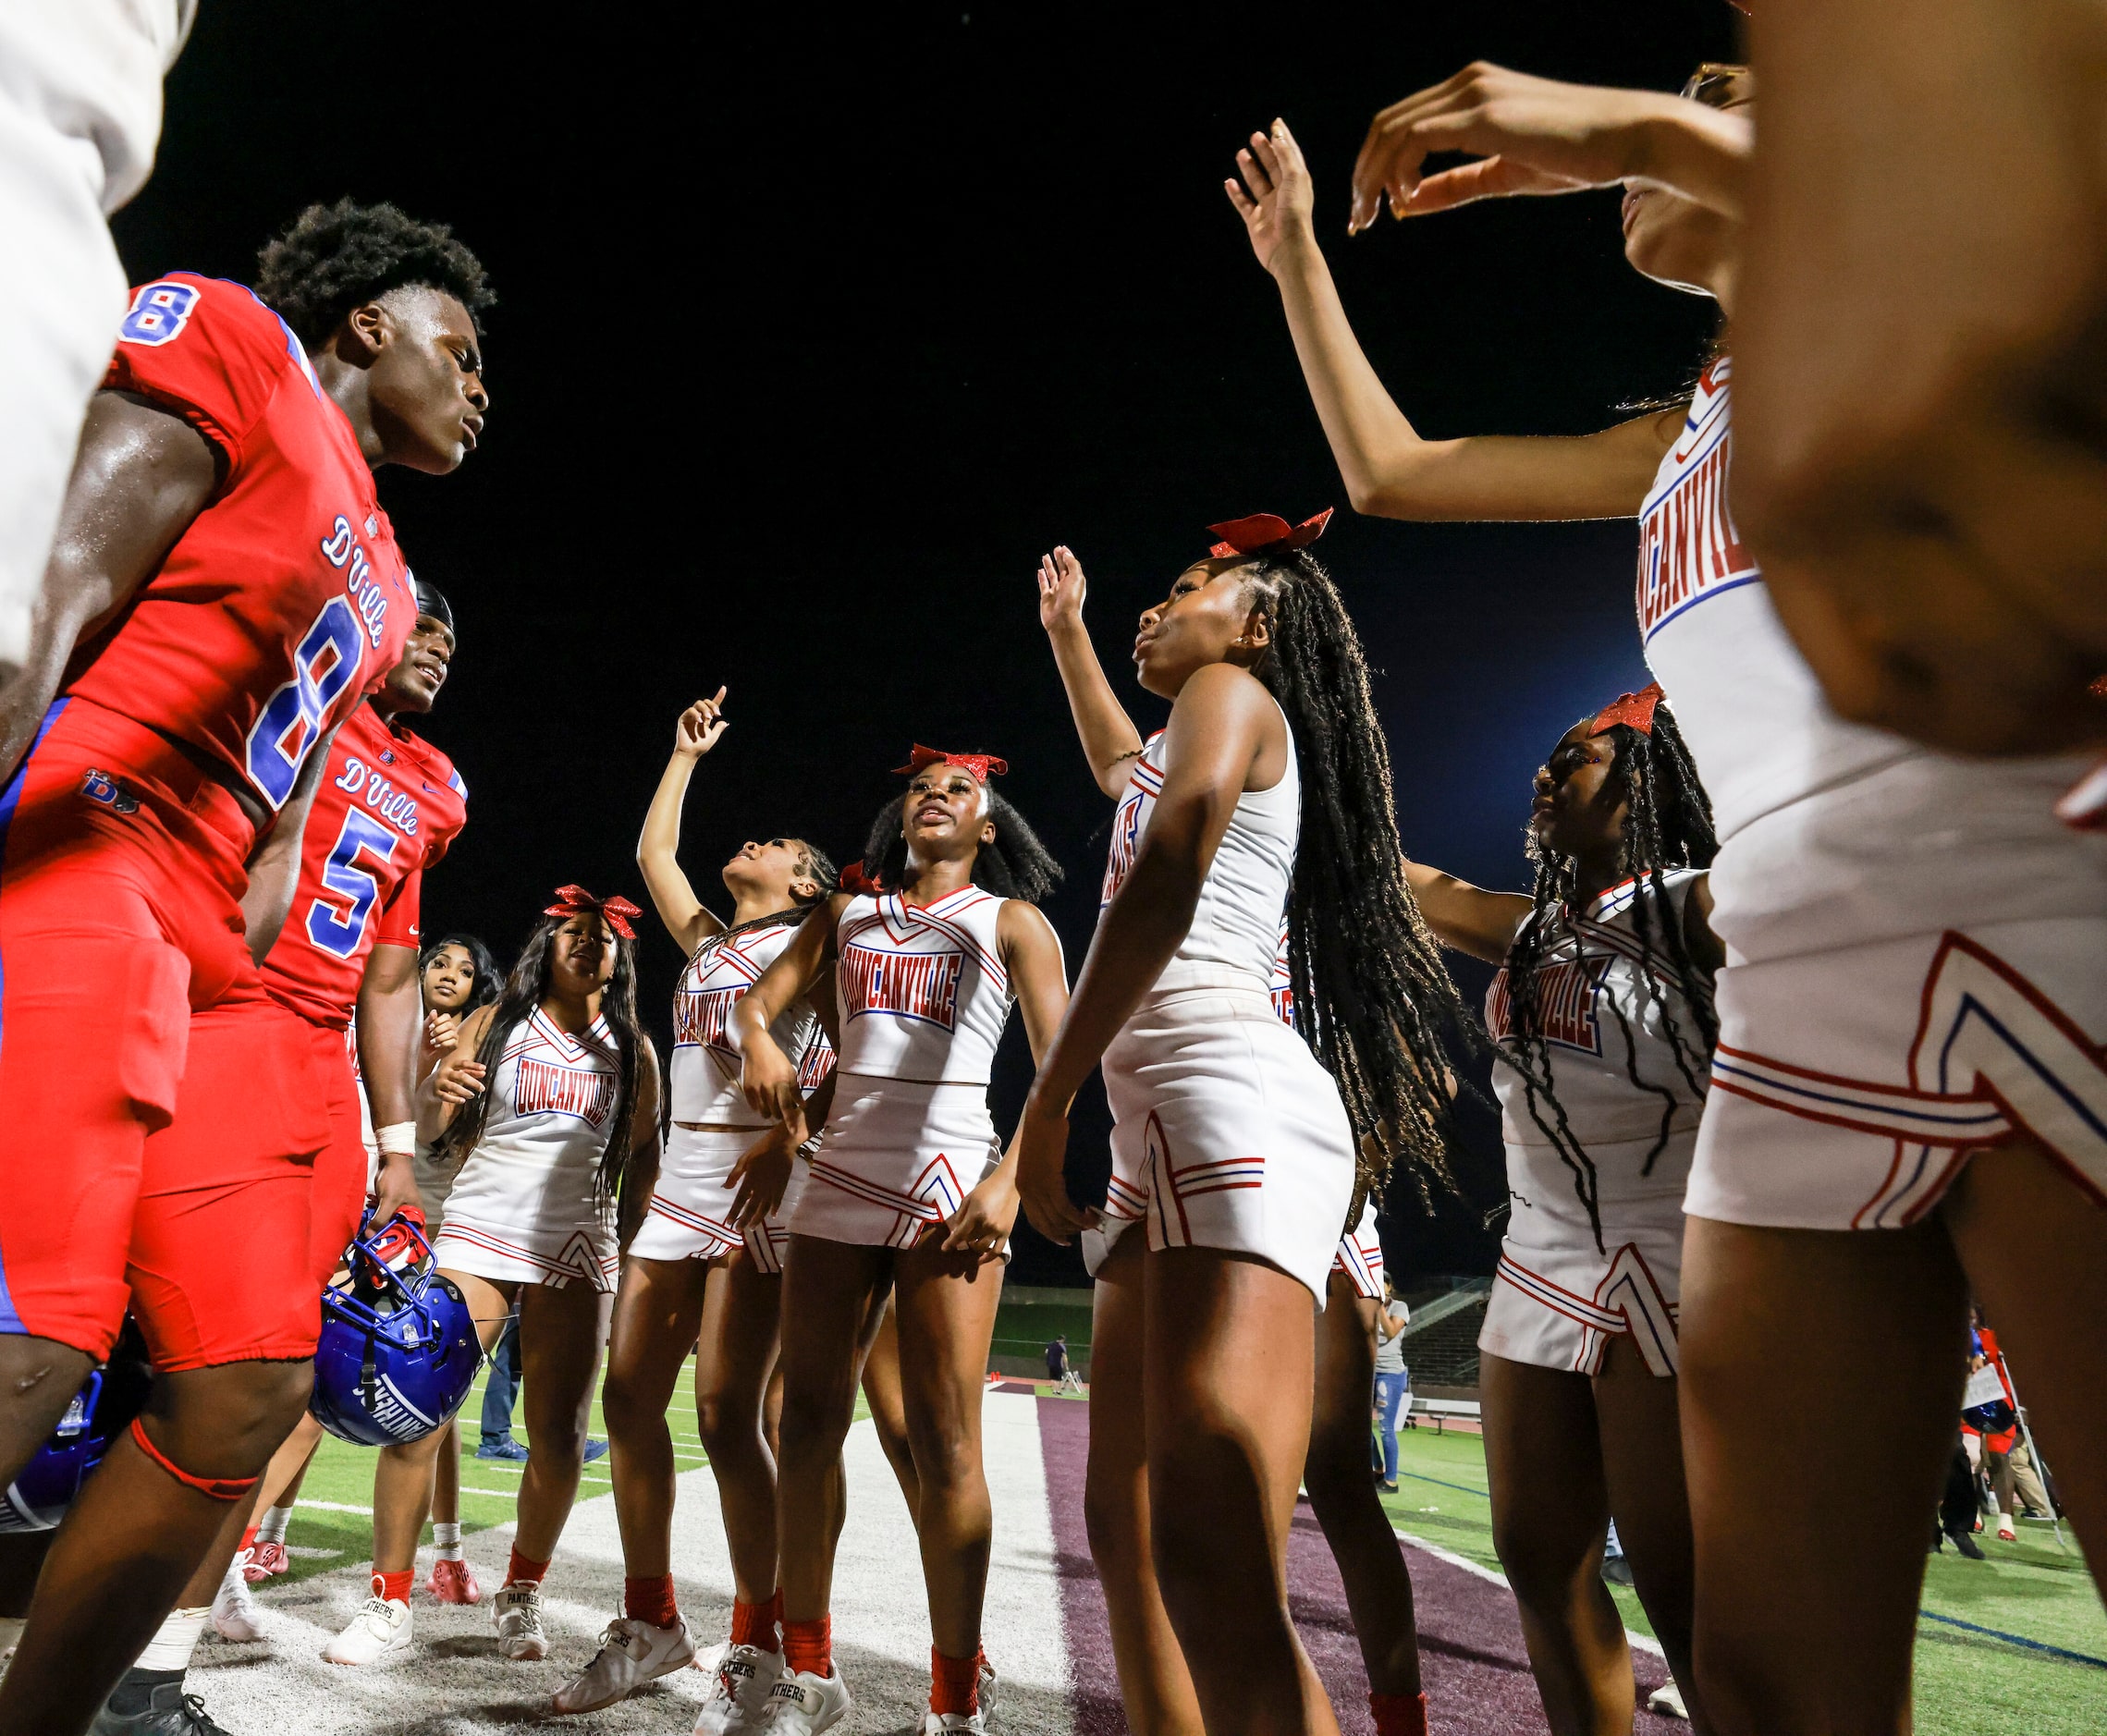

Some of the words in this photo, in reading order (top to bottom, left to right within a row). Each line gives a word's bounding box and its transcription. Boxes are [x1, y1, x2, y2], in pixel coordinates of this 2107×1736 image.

[117, 281, 202, 348] 8
[322, 514, 387, 649] D'Ville
[246, 593, 364, 812] 8
[335, 757, 419, 837] D'Ville
[305, 803, 399, 960] 5
[842, 946, 962, 1028] DUNCANVILLE
[518, 1059, 615, 1127] DUNCANVILLE
[507, 1593, 540, 1607] PANTHERS
